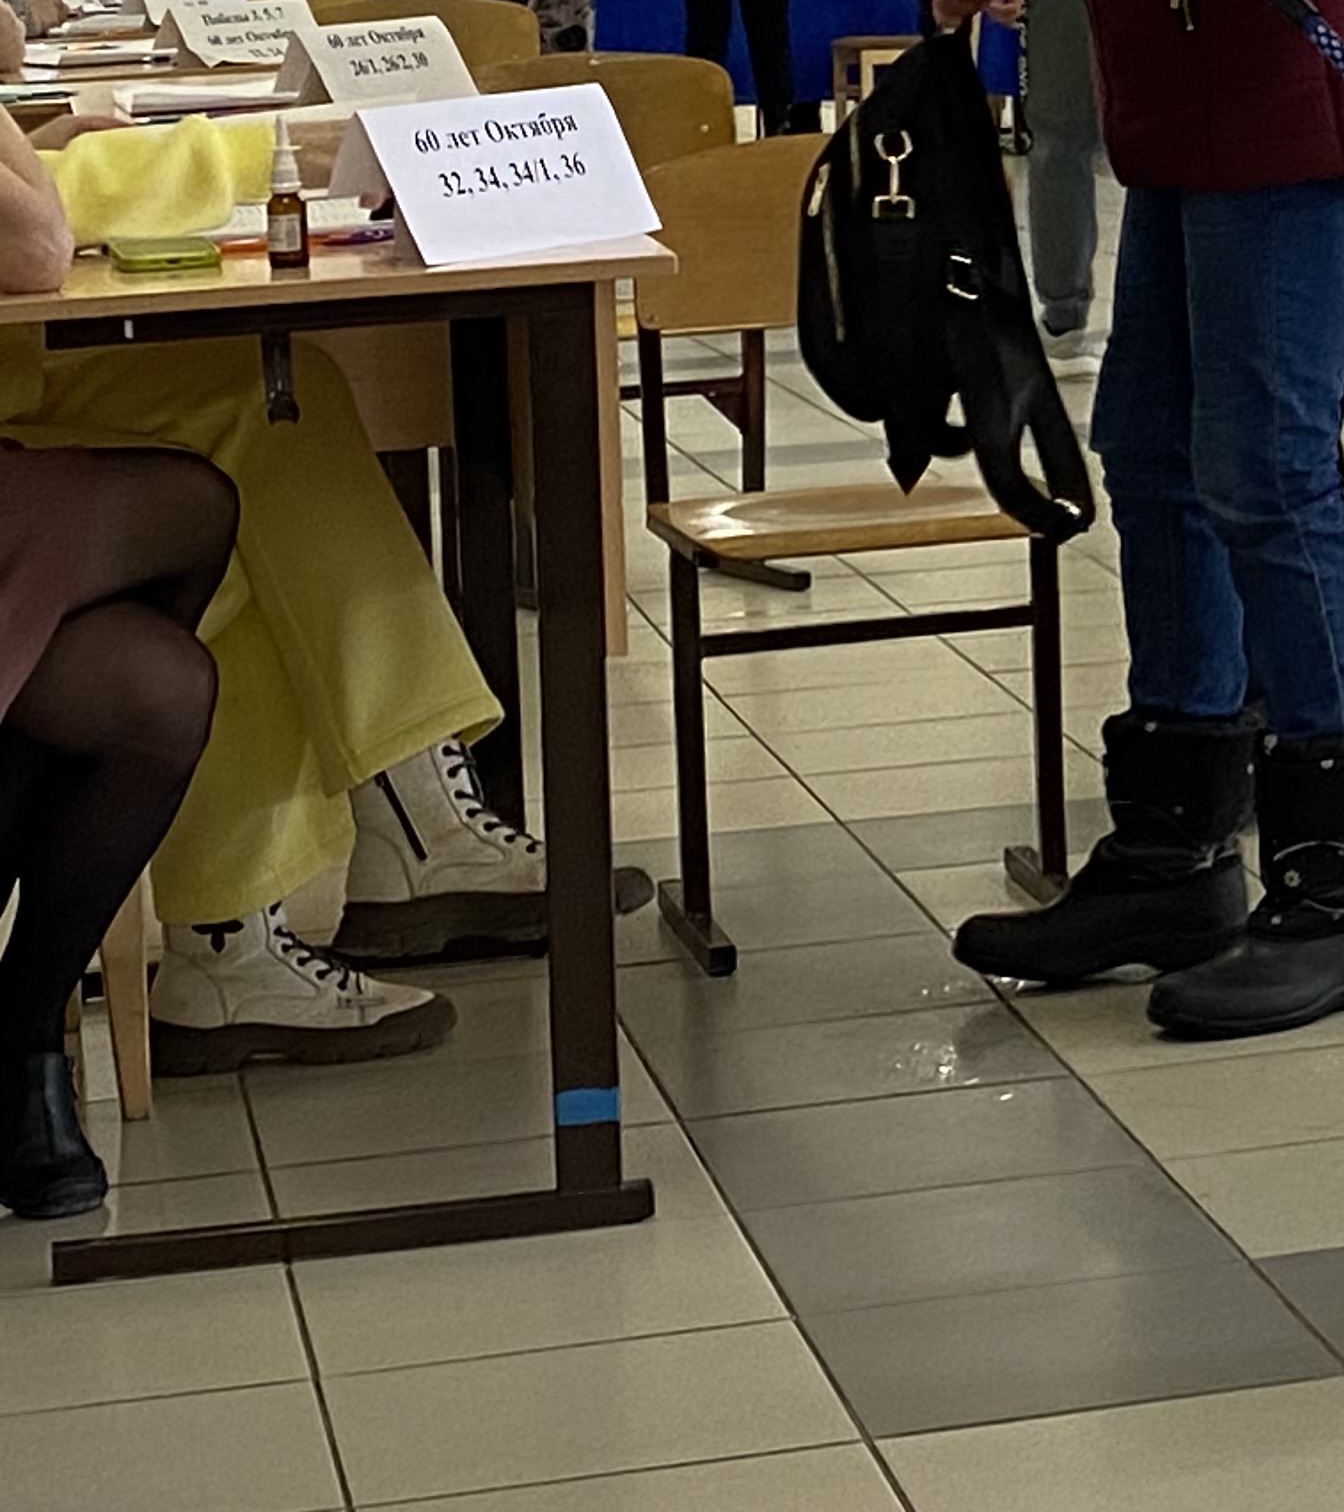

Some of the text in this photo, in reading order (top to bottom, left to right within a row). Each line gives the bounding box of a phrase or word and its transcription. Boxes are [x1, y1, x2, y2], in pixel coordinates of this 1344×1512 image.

[326, 26, 425, 49] 60 лет Октября
[414, 112, 578, 154] 60 лет Октября
[438, 152, 587, 199] 32, 34, 34/1, 36
